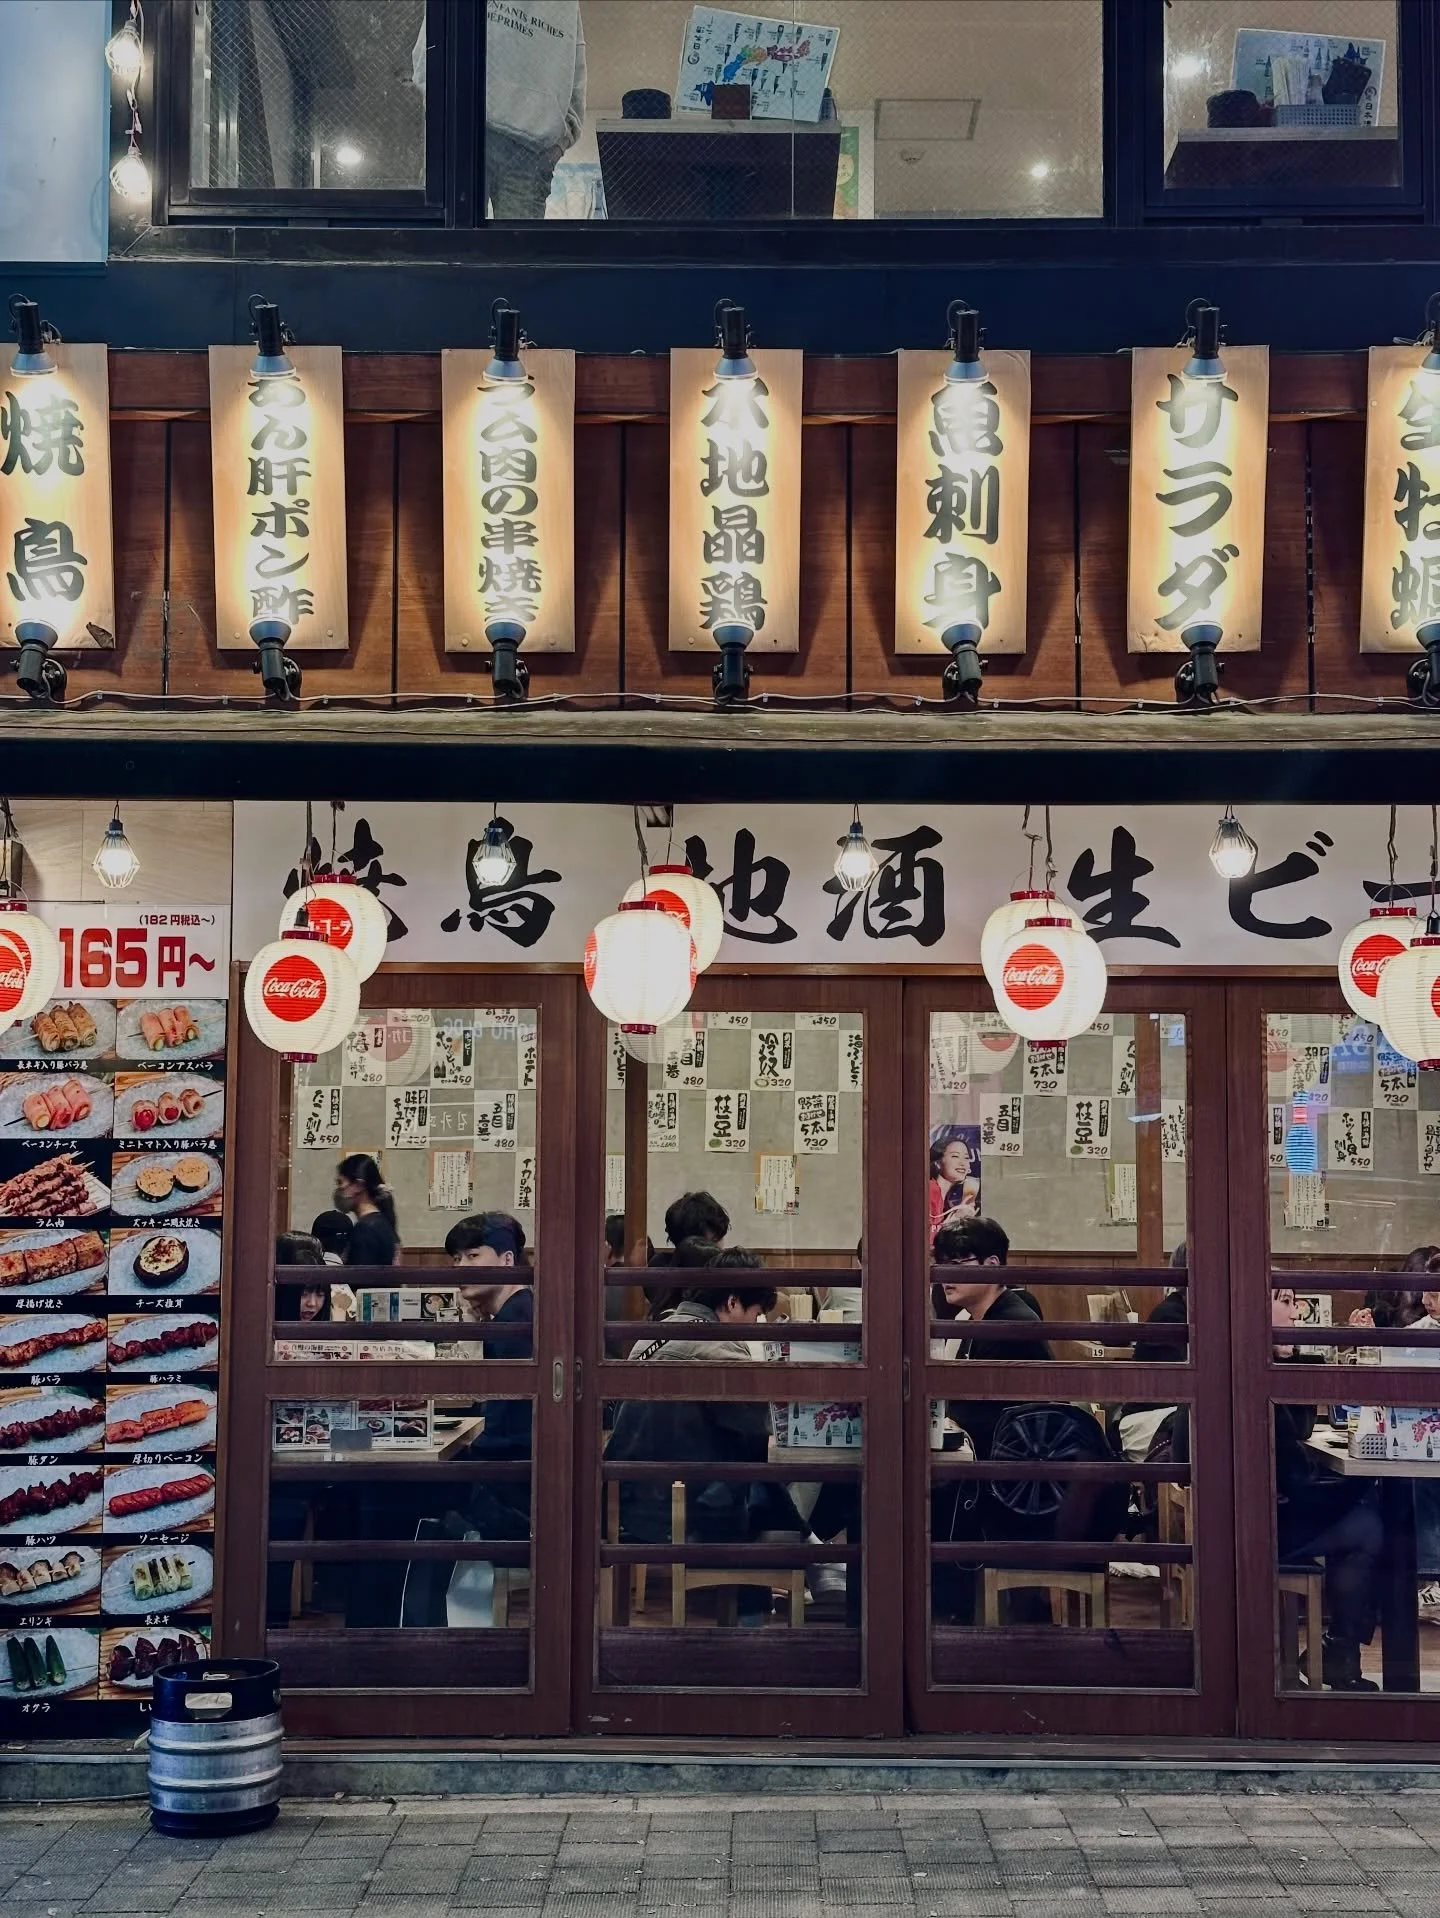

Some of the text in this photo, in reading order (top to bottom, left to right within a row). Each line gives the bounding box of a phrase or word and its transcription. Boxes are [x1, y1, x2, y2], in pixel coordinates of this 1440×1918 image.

[530, 16, 564, 38] RICHES
[1, 390, 88, 602] 焼鳥
[1154, 373, 1240, 631] サラダ
[758, 1032, 780, 1077] 冷奴
[137, 1061, 214, 1071] ベーコンアスパラ
[770, 1078, 792, 1088] 320
[1033, 1080, 1058, 1090] 730
[797, 1094, 824, 1110] 野菜
[1383, 1094, 1410, 1104] 730
[712, 1093, 733, 1138] 枝豆
[800, 1120, 825, 1136] 5本
[1074, 1101, 1094, 1145] 枝豆
[319, 1134, 340, 1144] 550
[724, 1138, 746, 1149] 320
[803, 1138, 828, 1148] 730
[21, 1140, 78, 1150] ベーコンチーズ
[1086, 1146, 1109, 1155] 320
[1350, 1157, 1371, 1167] 550
[35, 1218, 65, 1228] ラム肉
[1093, 1348, 1104, 1357] 19
[30, 1374, 61, 1385] 豚バラ
[149, 1374, 183, 1384] 豚ハラミ
[27, 1455, 59, 1465] 豚タン
[132, 1453, 204, 1464] 厚切りベーコン
[139, 1534, 191, 1544] ソーセージ
[19, 1616, 53, 1627] エリンギ
[144, 1614, 170, 1626] 長ネギ
[21, 1702, 51, 1713] オクラ
